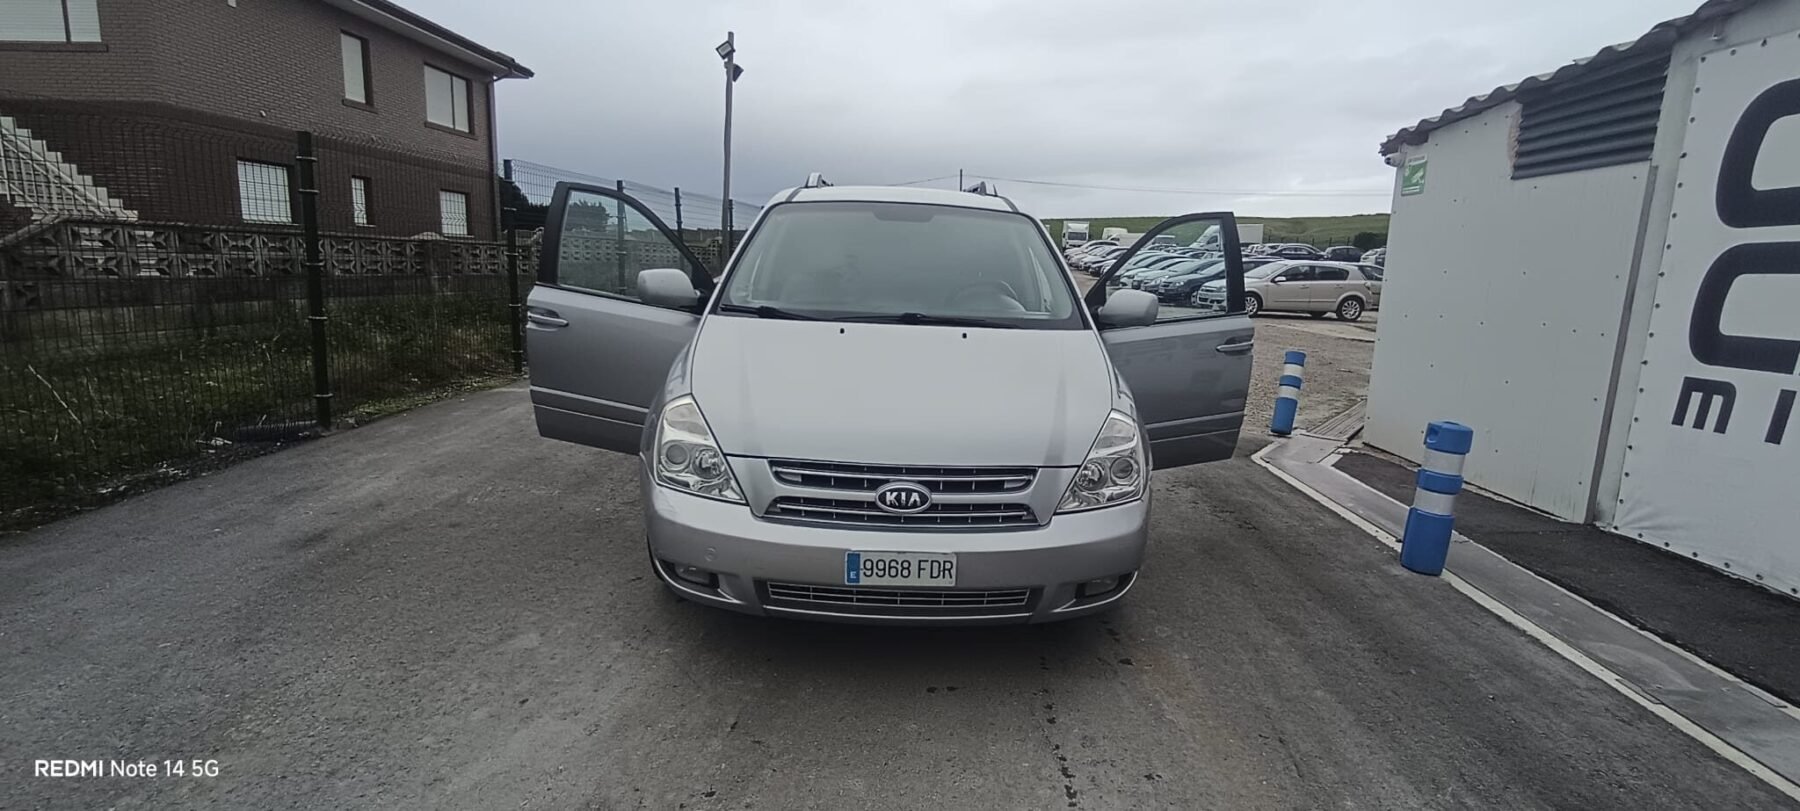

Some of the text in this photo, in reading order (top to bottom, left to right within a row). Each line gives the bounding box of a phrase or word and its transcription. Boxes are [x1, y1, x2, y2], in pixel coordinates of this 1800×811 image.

[885, 491, 921, 507] KIA
[850, 558, 953, 580] E 9968 FDR
